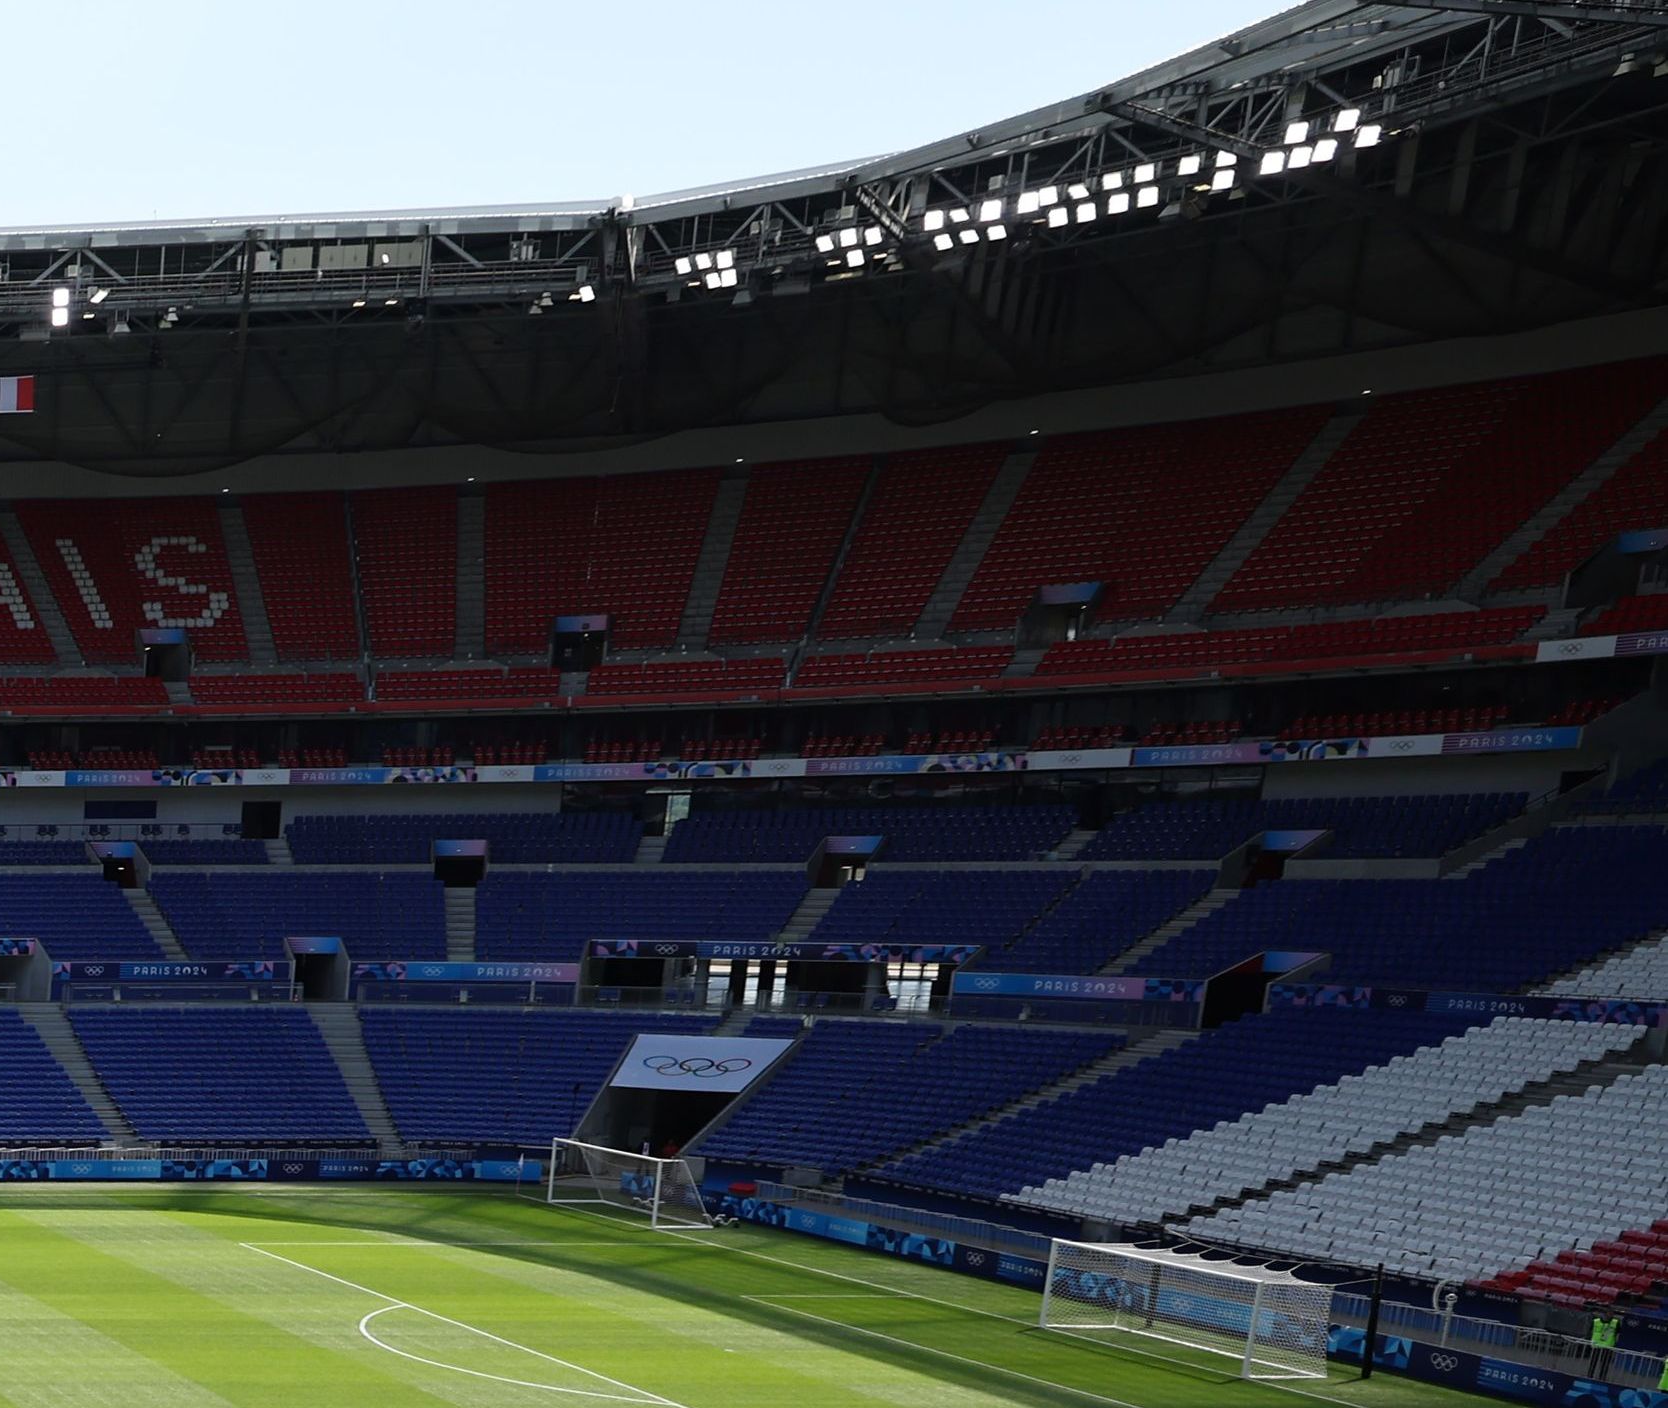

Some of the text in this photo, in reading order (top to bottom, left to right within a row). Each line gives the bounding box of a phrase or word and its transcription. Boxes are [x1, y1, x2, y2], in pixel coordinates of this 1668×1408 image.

[1635, 637, 1668, 649] PAR
[1511, 734, 1553, 745] 2024
[1201, 748, 1242, 759] 2024
[865, 761, 902, 770] 2024
[111, 774, 141, 782] 2024
[340, 772, 372, 780] 2024
[713, 945, 801, 956] PARIS 2024
[133, 966, 208, 976] PARIS 2024
[477, 967, 562, 976] PARIS 2024
[1034, 981, 1126, 993] PARIS 2024
[1448, 999, 1525, 1012] PARIS 2024
[1484, 1368, 1554, 1391] PARIS 2024
